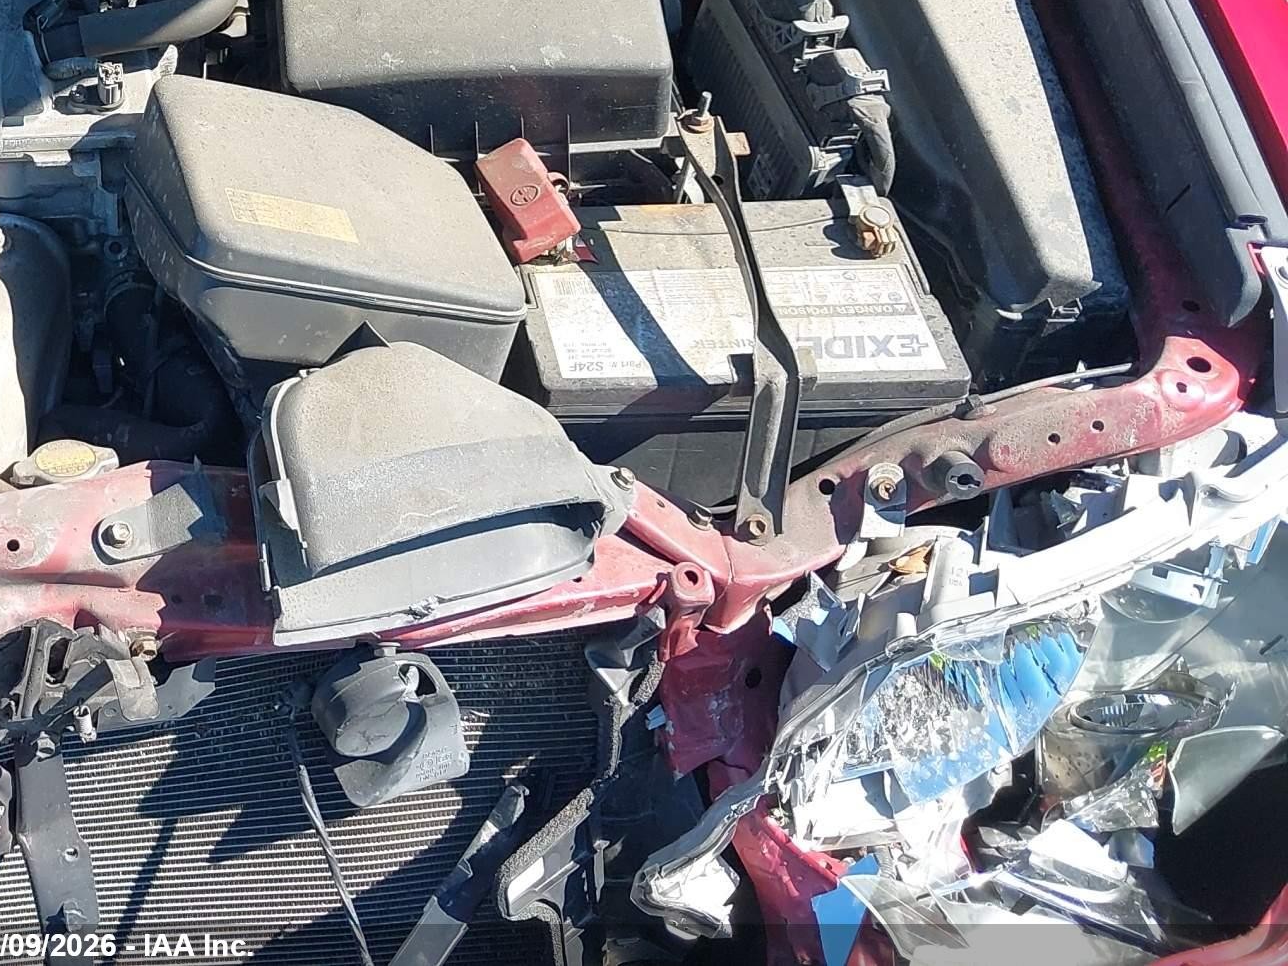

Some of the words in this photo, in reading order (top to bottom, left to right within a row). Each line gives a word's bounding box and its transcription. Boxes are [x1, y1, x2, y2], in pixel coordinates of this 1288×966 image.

[778, 305, 829, 316] POISON
[838, 303, 891, 314] DANGER
[569, 361, 604, 372] S24F
[621, 360, 642, 369] Part
